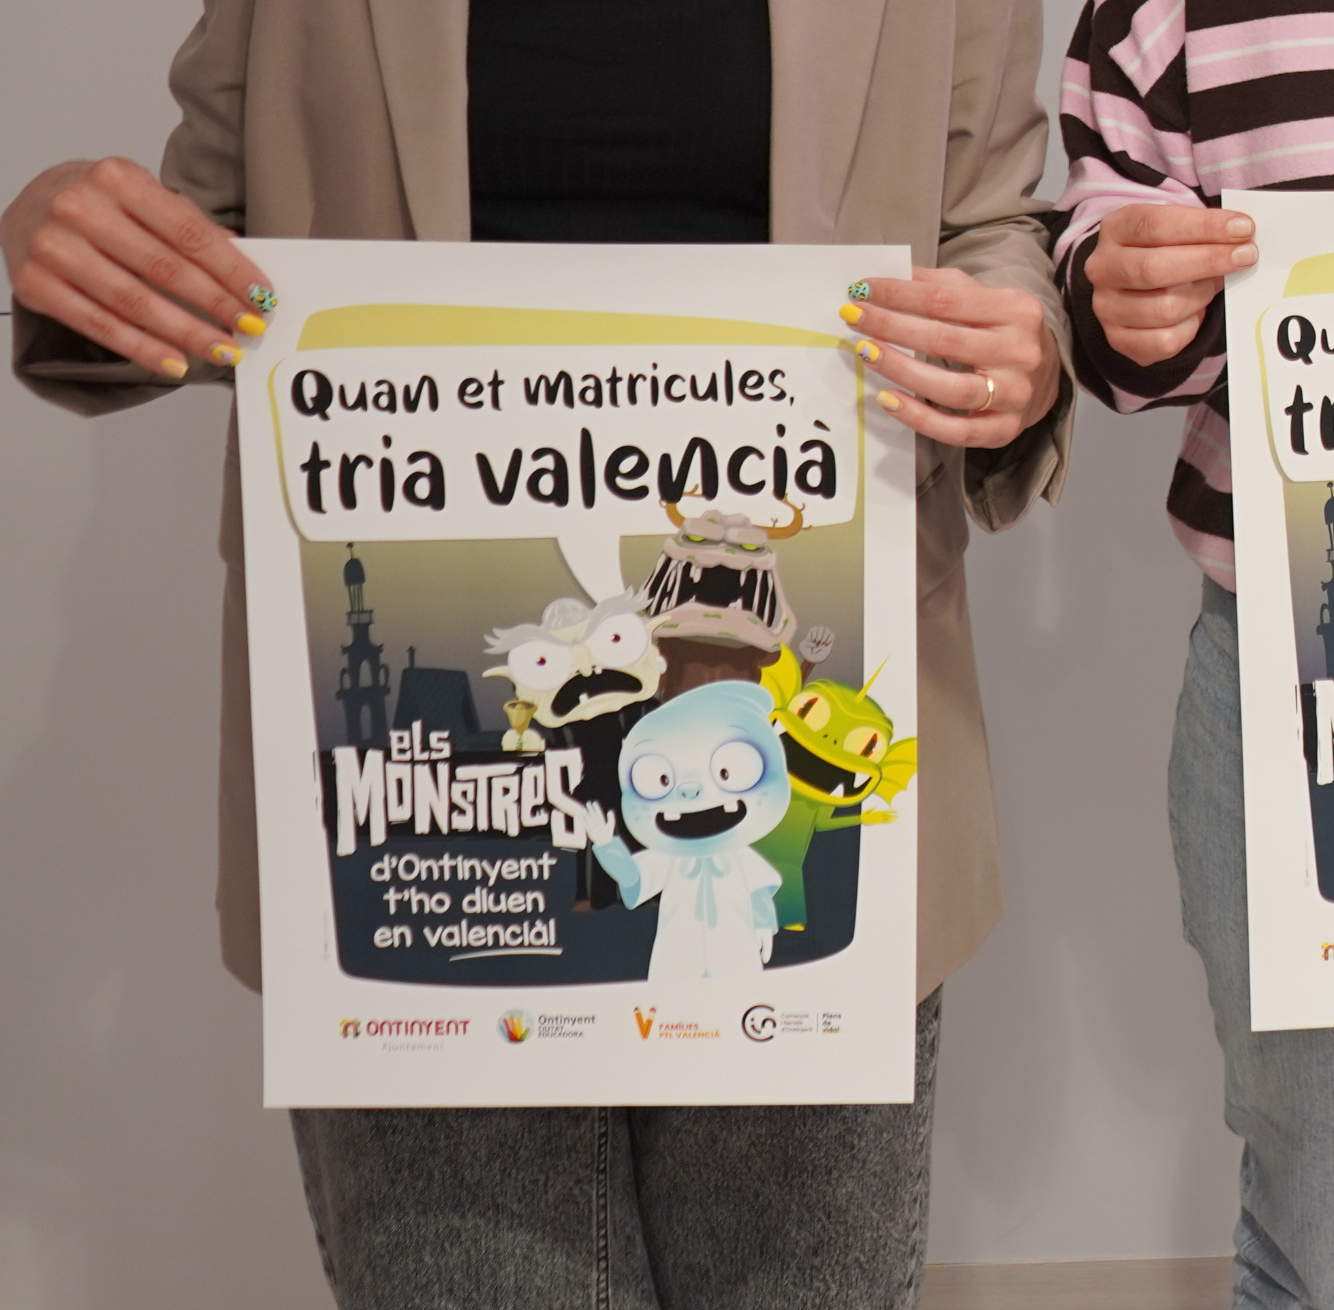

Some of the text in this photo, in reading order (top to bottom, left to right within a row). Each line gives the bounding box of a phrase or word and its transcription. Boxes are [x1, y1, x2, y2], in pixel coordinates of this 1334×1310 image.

[290, 359, 795, 419] Quan et matricules,
[300, 419, 838, 514] tria valencià
[369, 851, 558, 887] d'Ontinyent
[382, 887, 546, 915] t'ho diuen
[373, 918, 558, 948] en valencià!
[366, 1019, 470, 1037] ONTINYENT
[538, 1014, 596, 1026] Ontinyent
